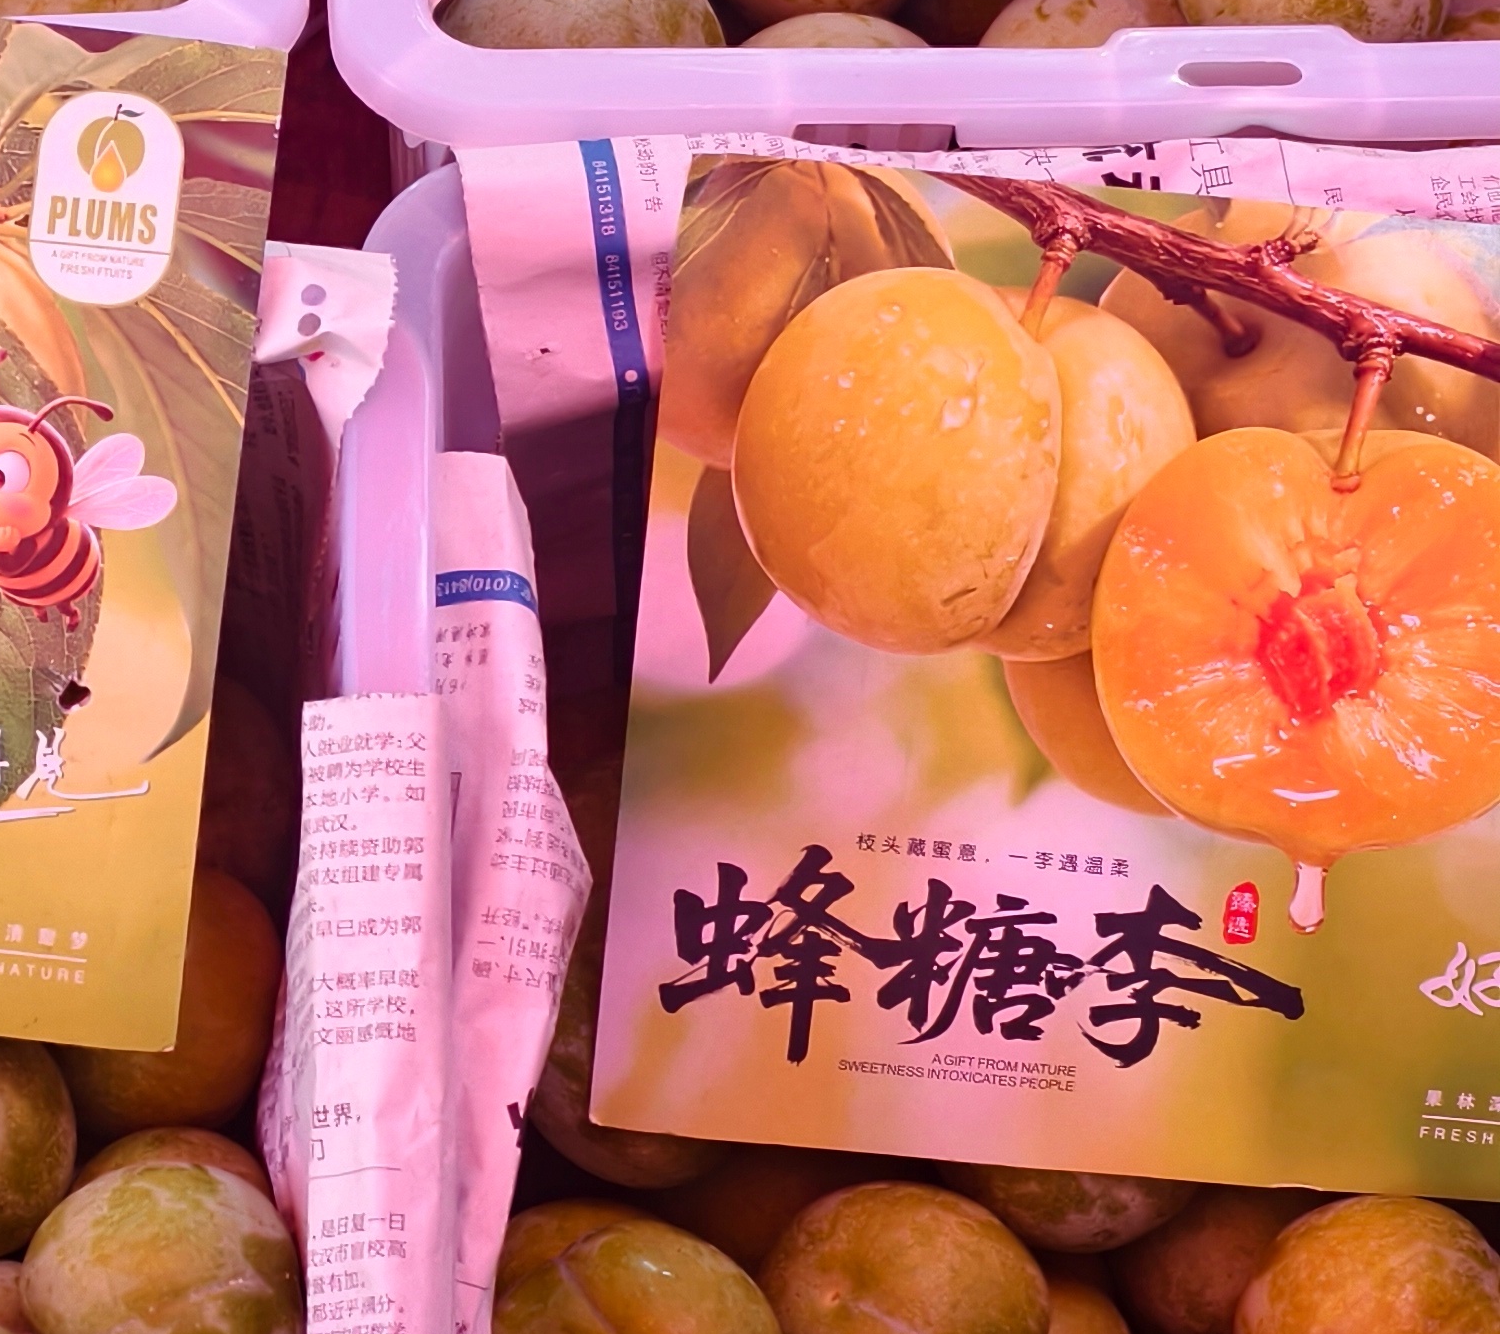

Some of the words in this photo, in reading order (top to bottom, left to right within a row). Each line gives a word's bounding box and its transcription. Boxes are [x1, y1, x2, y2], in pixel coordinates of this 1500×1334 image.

[592, 160, 616, 236] 84151318
[47, 195, 157, 244] PLUMS
[659, 843, 1306, 1068] 蜂糖李
[838, 1058, 925, 1079] SWEETNESS
[927, 1067, 1017, 1088] INTOXICATES
[1019, 1077, 1075, 1092] PEOPLE
[931, 1053, 942, 1065] A
[944, 1055, 975, 1069] GIFT
[977, 1057, 1018, 1073] FROM
[1020, 1061, 1077, 1078] NATURE
[1419, 1125, 1494, 1146] FRESH
